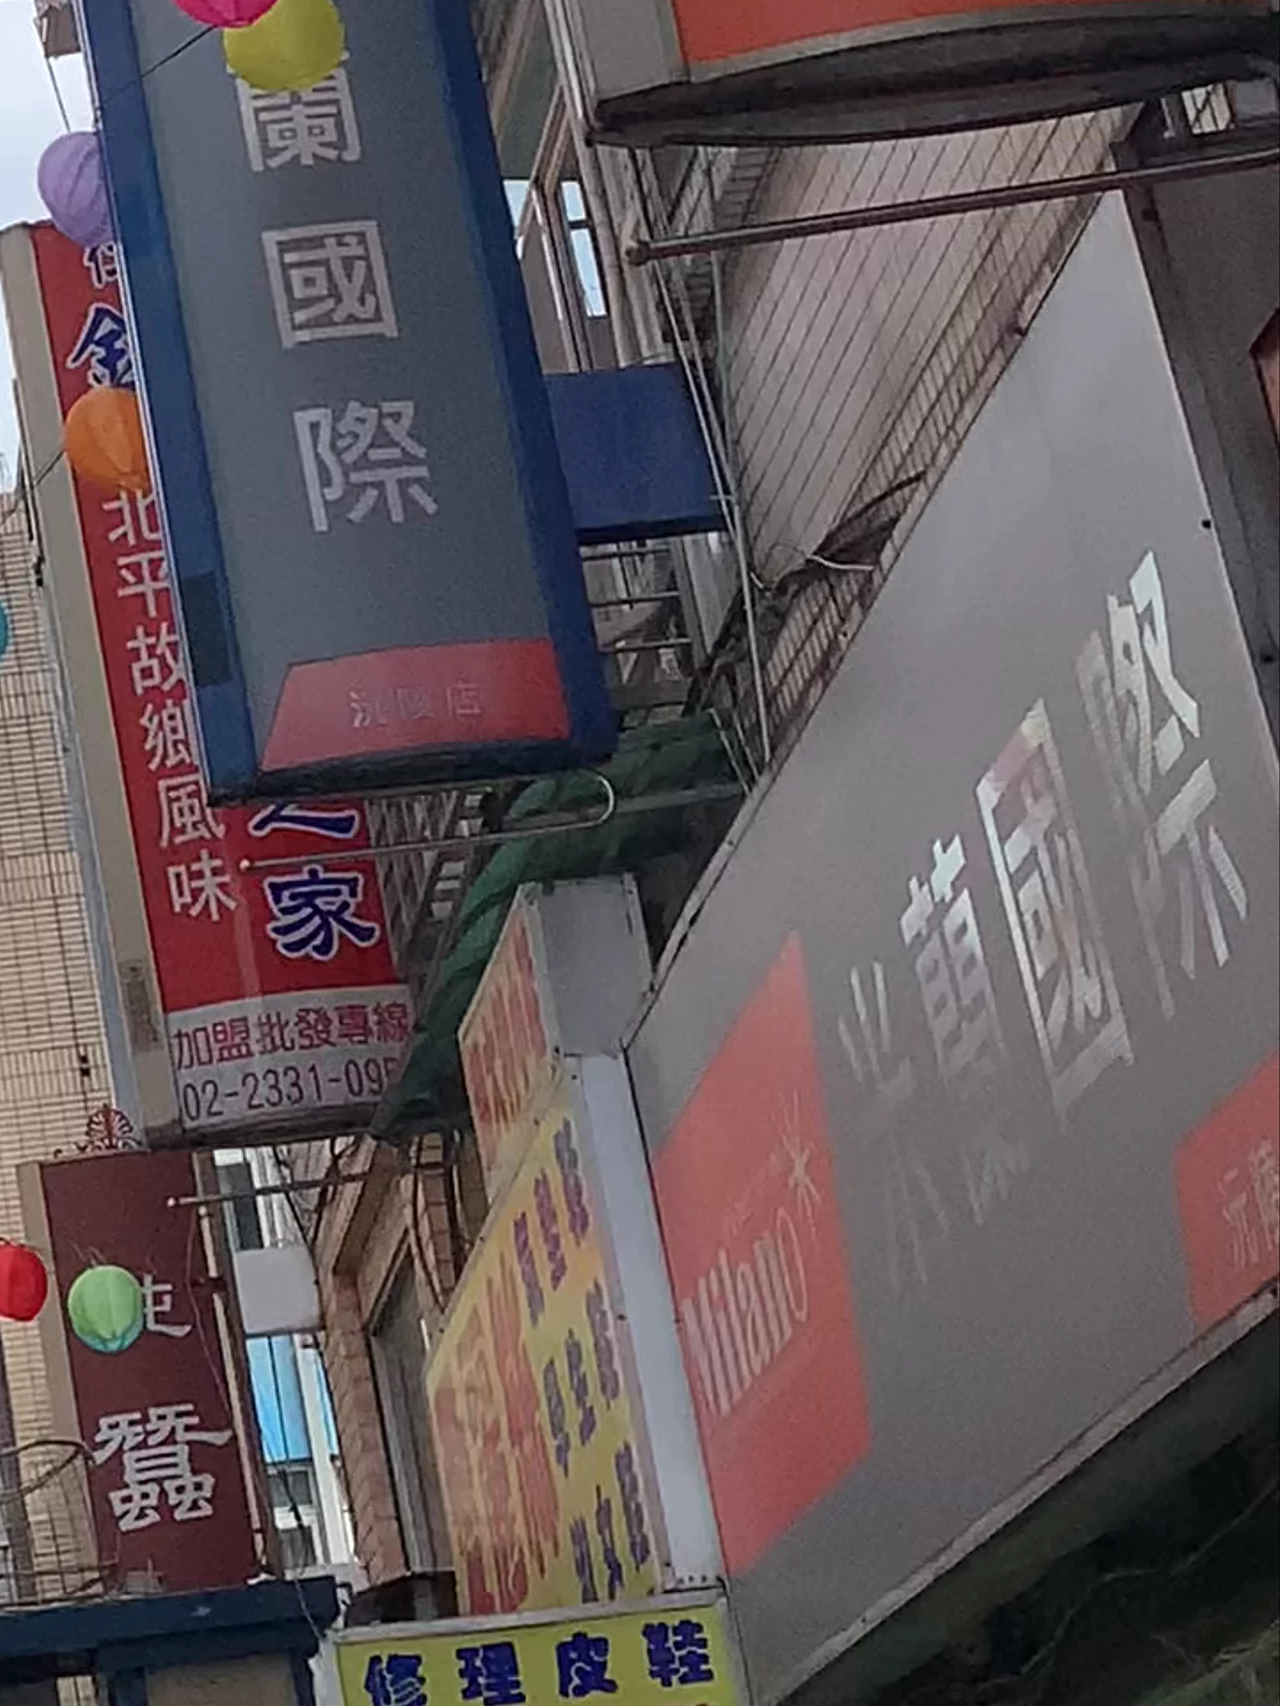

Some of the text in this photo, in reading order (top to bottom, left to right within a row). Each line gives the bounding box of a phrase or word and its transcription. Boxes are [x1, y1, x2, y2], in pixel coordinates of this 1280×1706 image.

[102, 489, 238, 922] 北平故鄉風味
[175, 999, 410, 1071] 加盟批發專線
[681, 1207, 809, 1418] Milano
